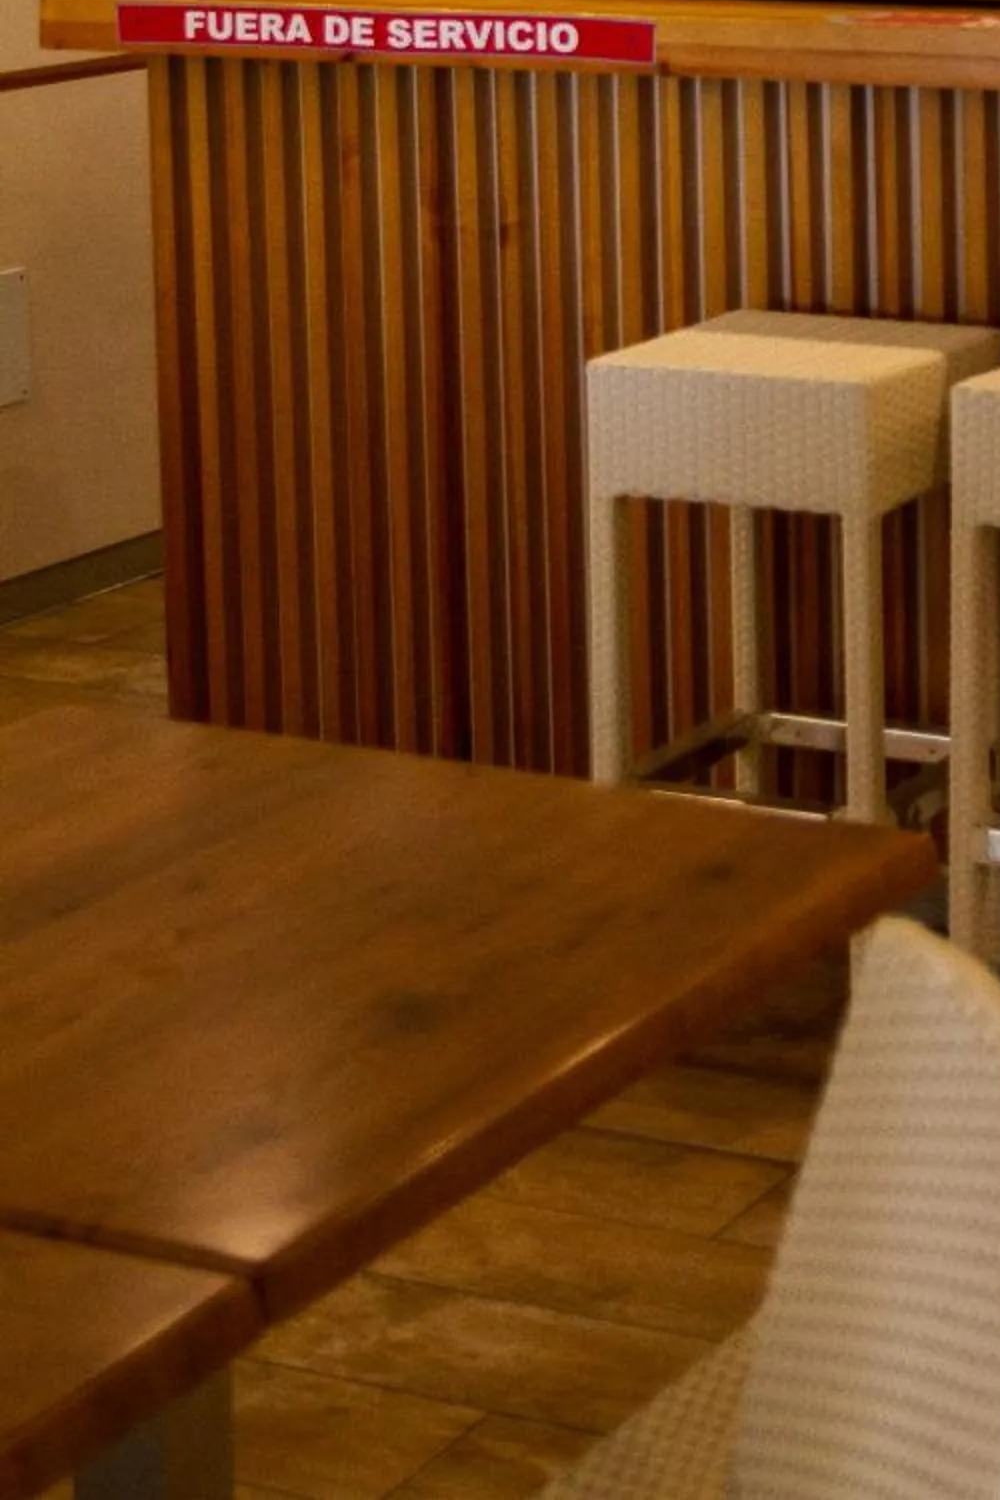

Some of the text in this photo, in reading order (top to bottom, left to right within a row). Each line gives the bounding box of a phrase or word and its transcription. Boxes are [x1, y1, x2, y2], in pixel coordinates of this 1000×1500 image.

[184, 10, 579, 53] FUERA DE SERVICIO
